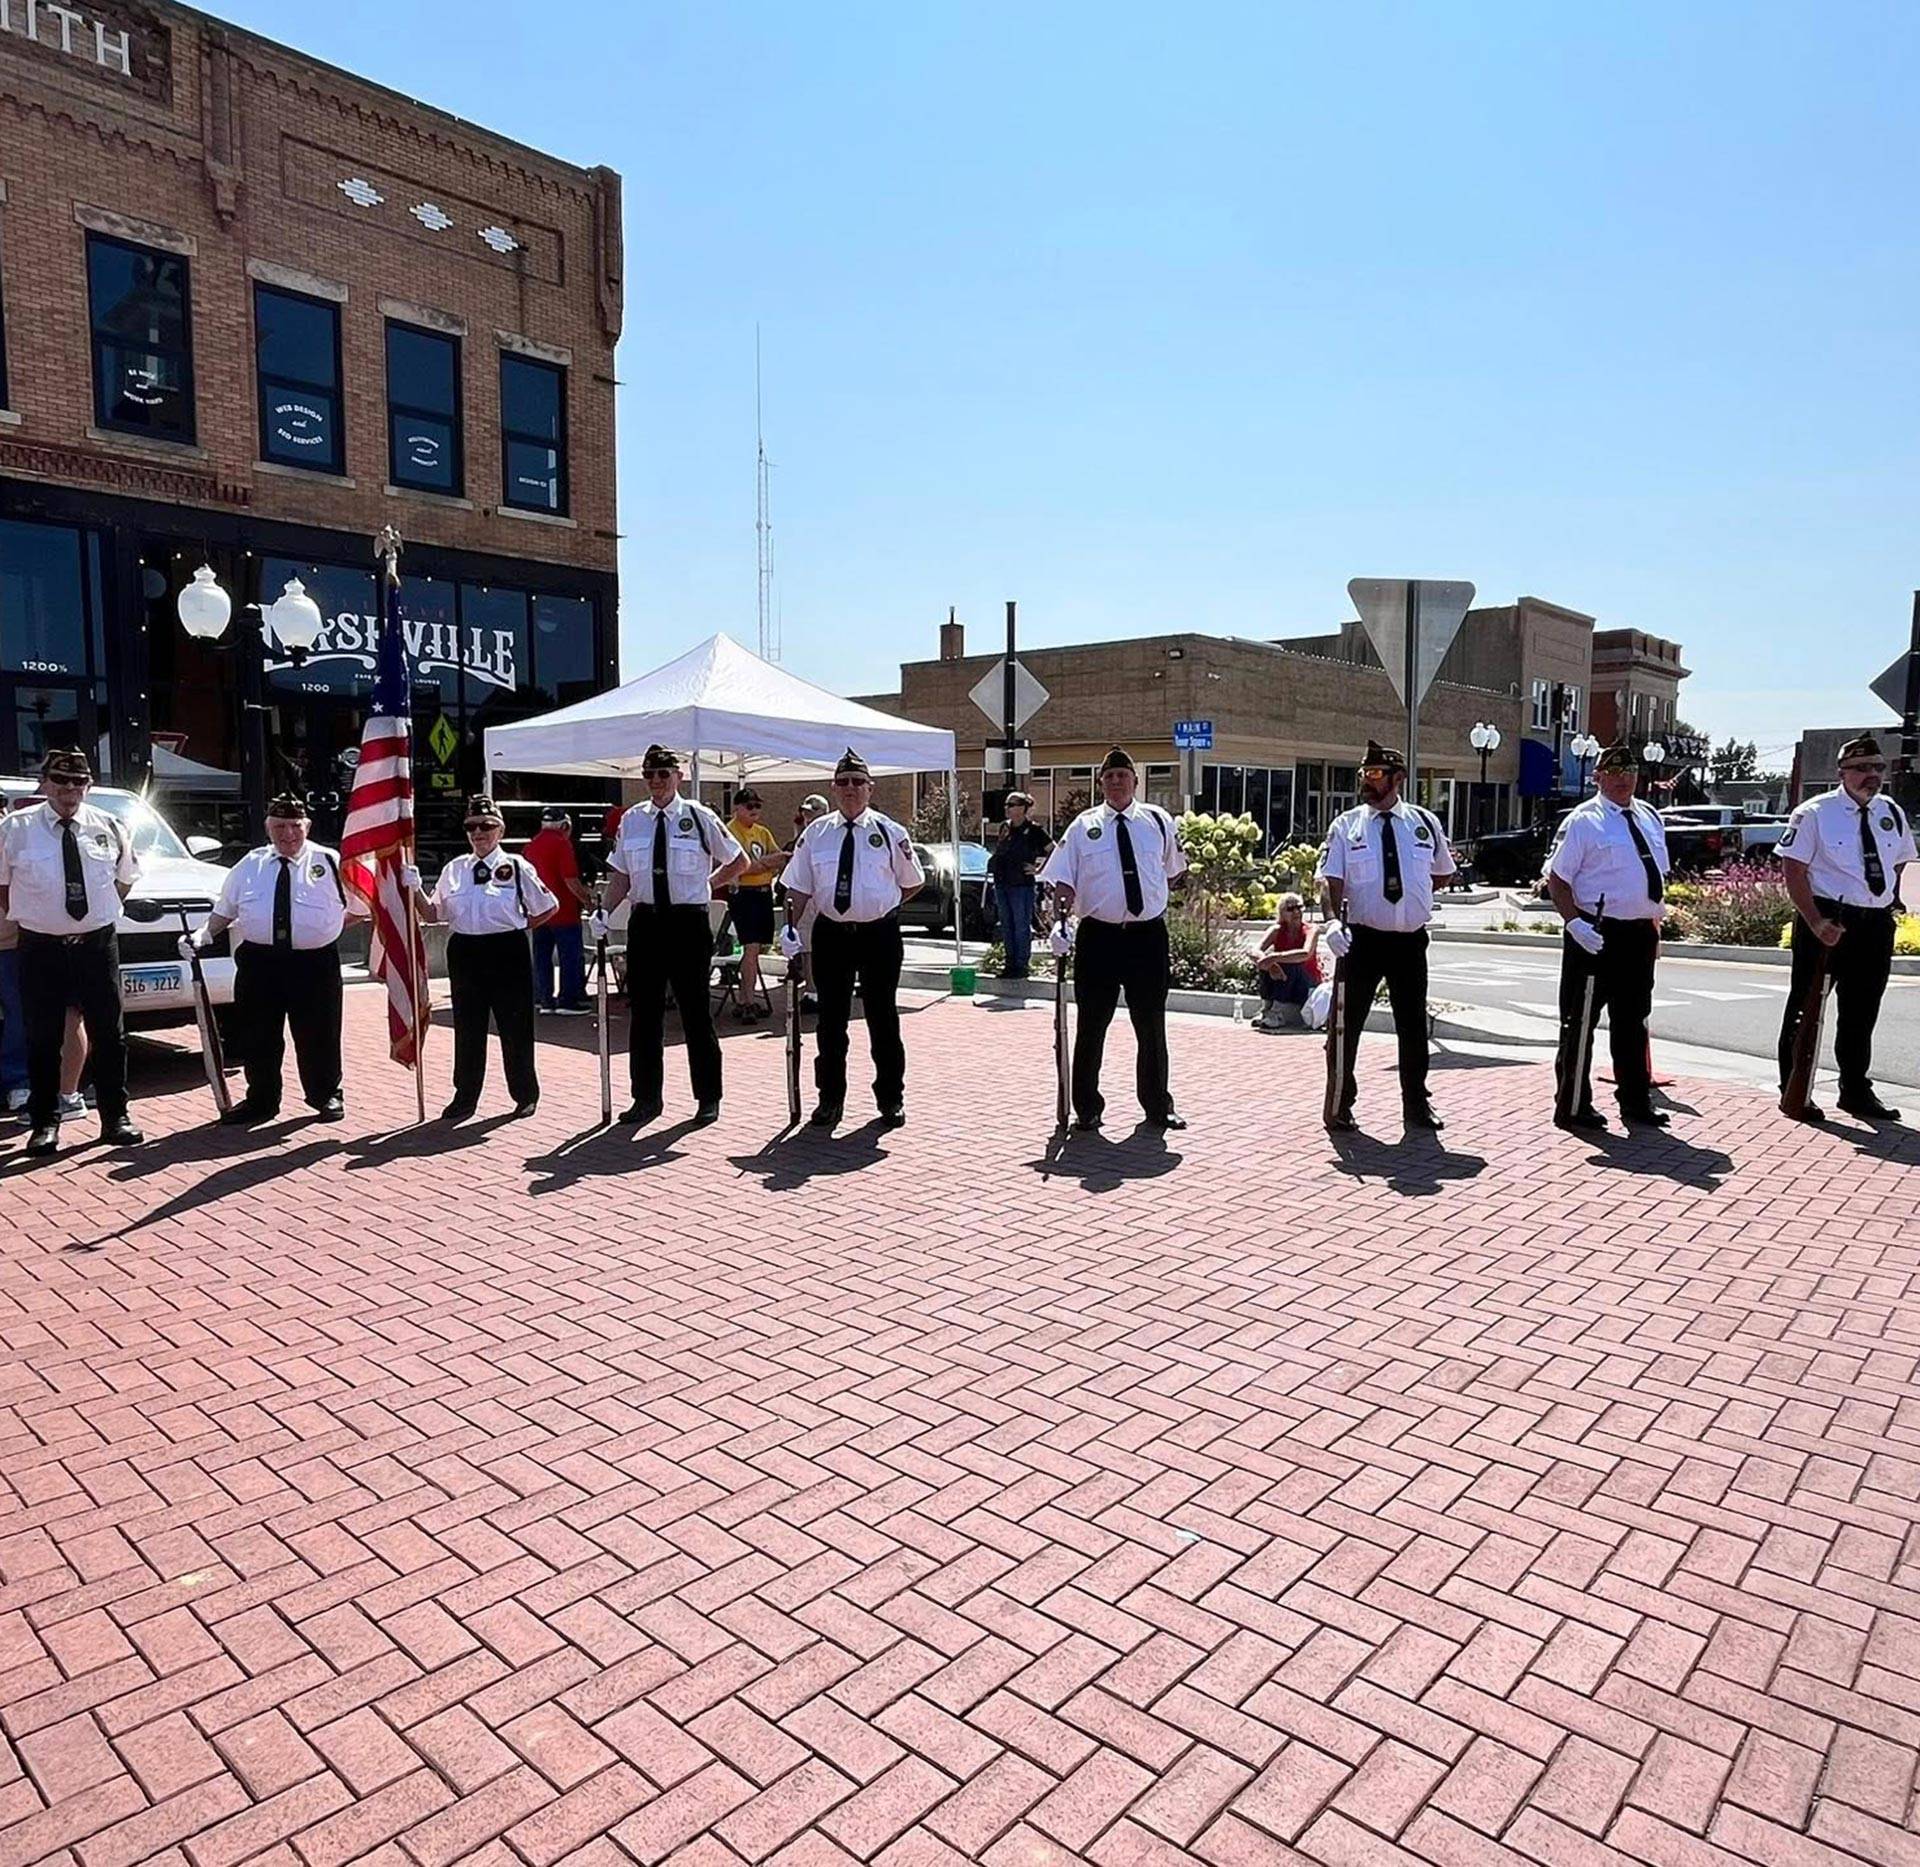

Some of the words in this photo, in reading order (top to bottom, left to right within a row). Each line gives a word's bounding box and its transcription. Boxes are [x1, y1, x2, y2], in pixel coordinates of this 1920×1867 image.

[0, 0, 132, 77] ITH
[275, 404, 293, 414] WEB
[293, 404, 323, 422] DESIGN
[291, 420, 308, 428] and
[292, 435, 324, 445] SERVICES
[301, 682, 331, 693] 1200
